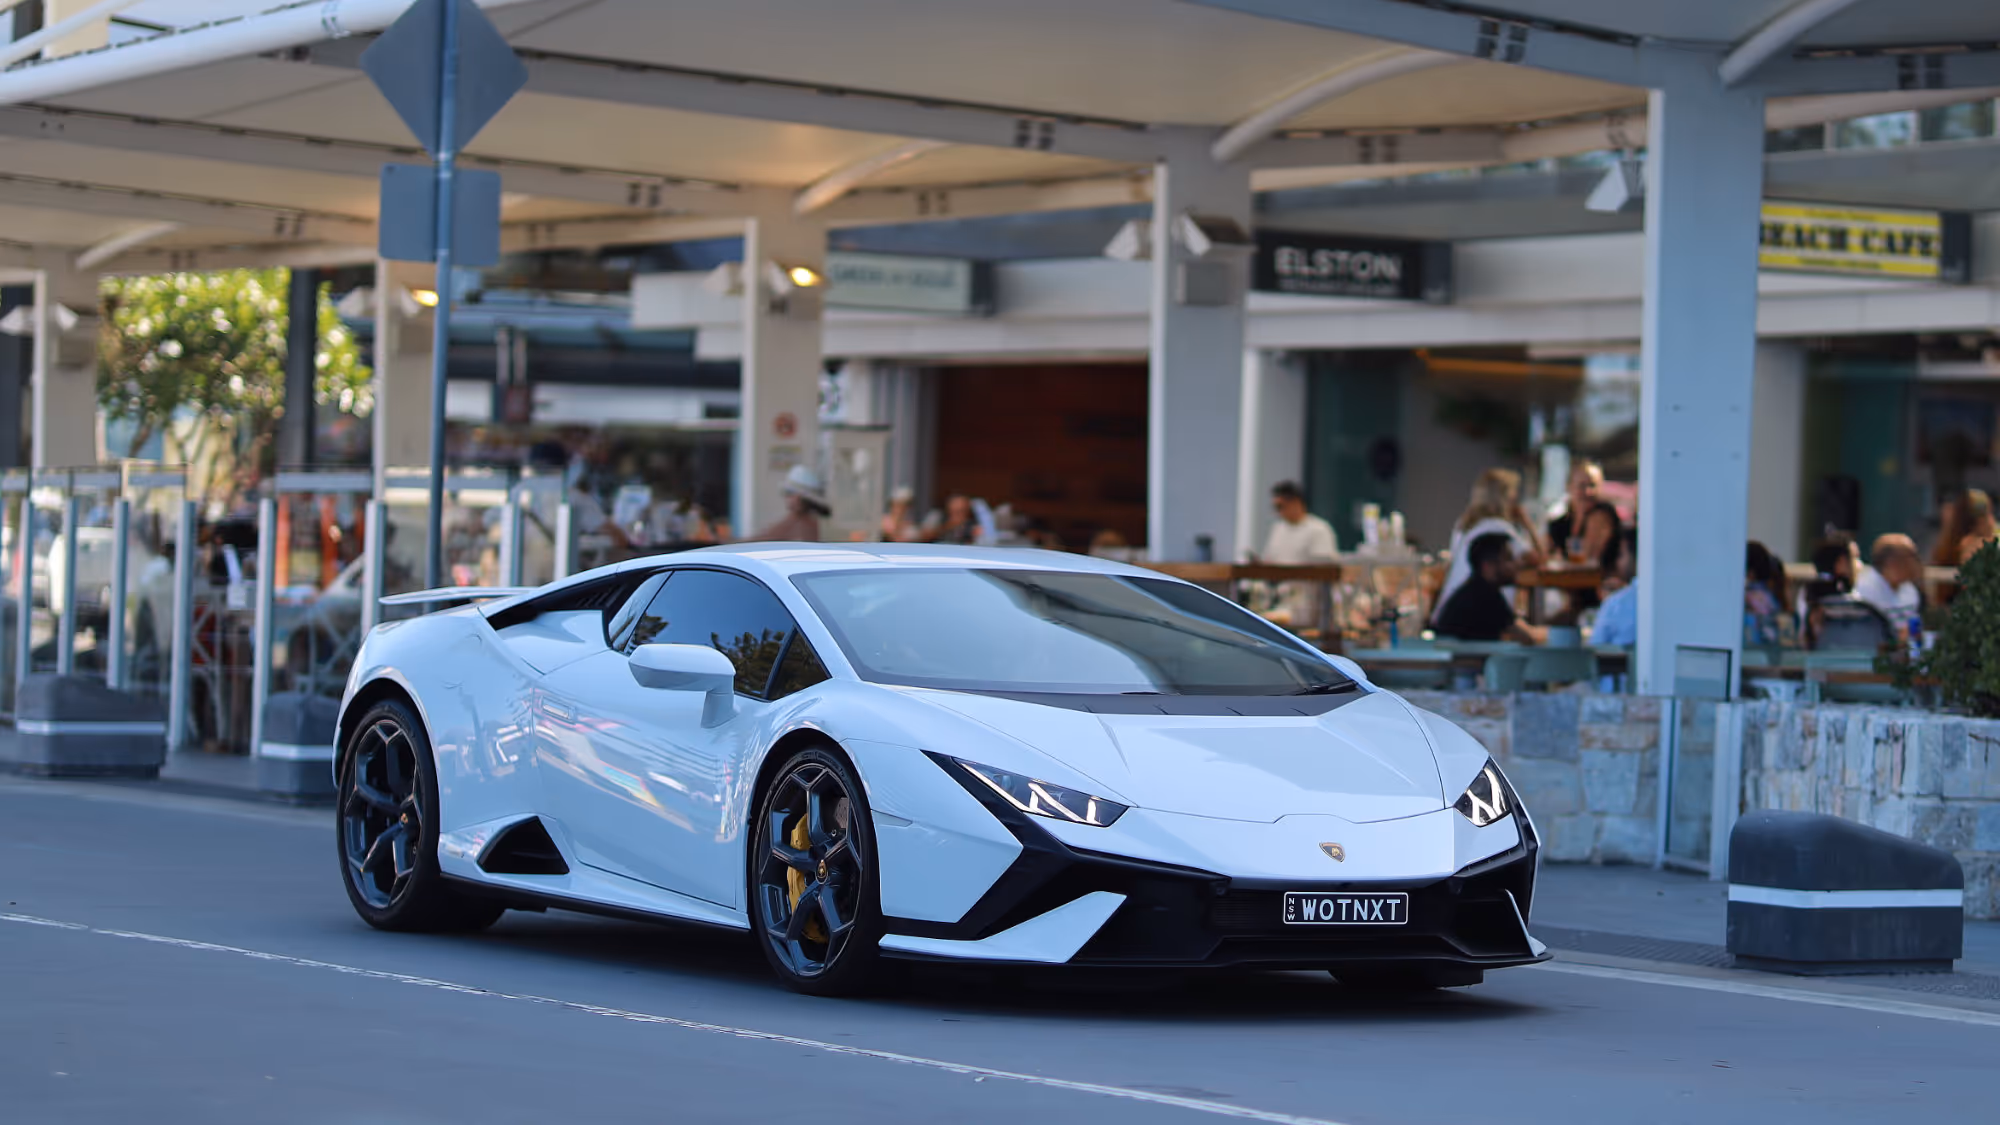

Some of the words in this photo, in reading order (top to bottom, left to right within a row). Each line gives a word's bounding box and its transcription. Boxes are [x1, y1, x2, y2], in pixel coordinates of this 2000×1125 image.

[1275, 246, 1401, 279] ELSTON
[1287, 897, 1296, 921] NSW
[1302, 898, 1401, 921] WOTNXT
